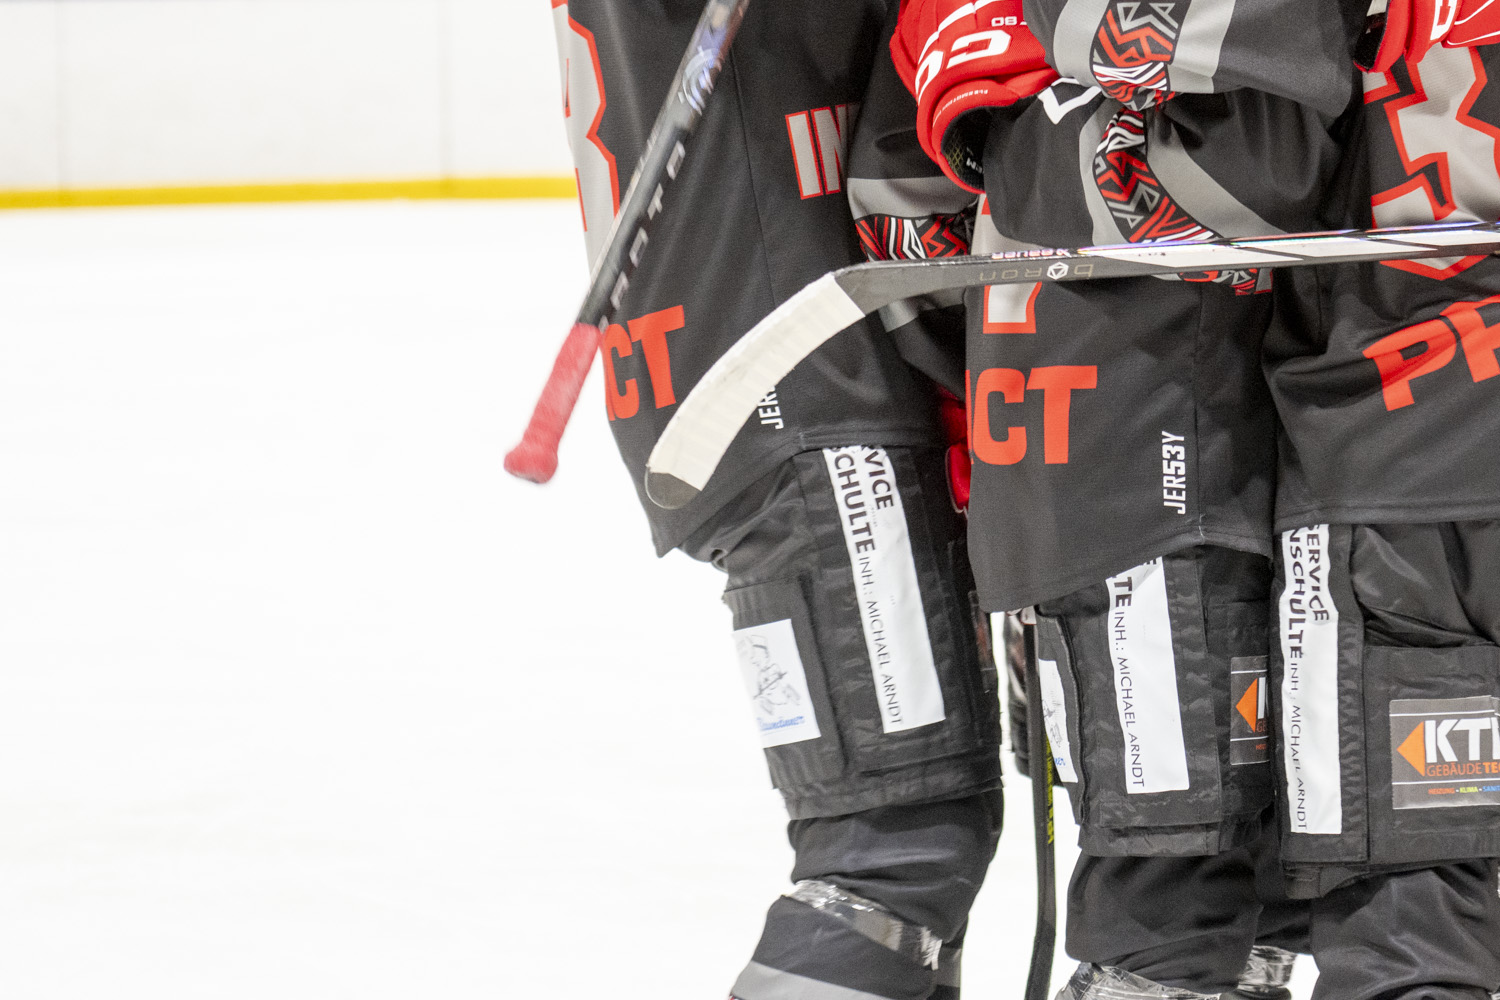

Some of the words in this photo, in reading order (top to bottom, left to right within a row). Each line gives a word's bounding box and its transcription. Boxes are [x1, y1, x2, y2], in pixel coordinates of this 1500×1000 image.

[863, 450, 894, 510] VICE
[834, 452, 876, 555] CHULTE
[866, 600, 891, 668] MICHAEL
[881, 673, 903, 725] ARNDT
[1117, 656, 1136, 728] MICHAEL
[1128, 732, 1145, 788] ARNDT
